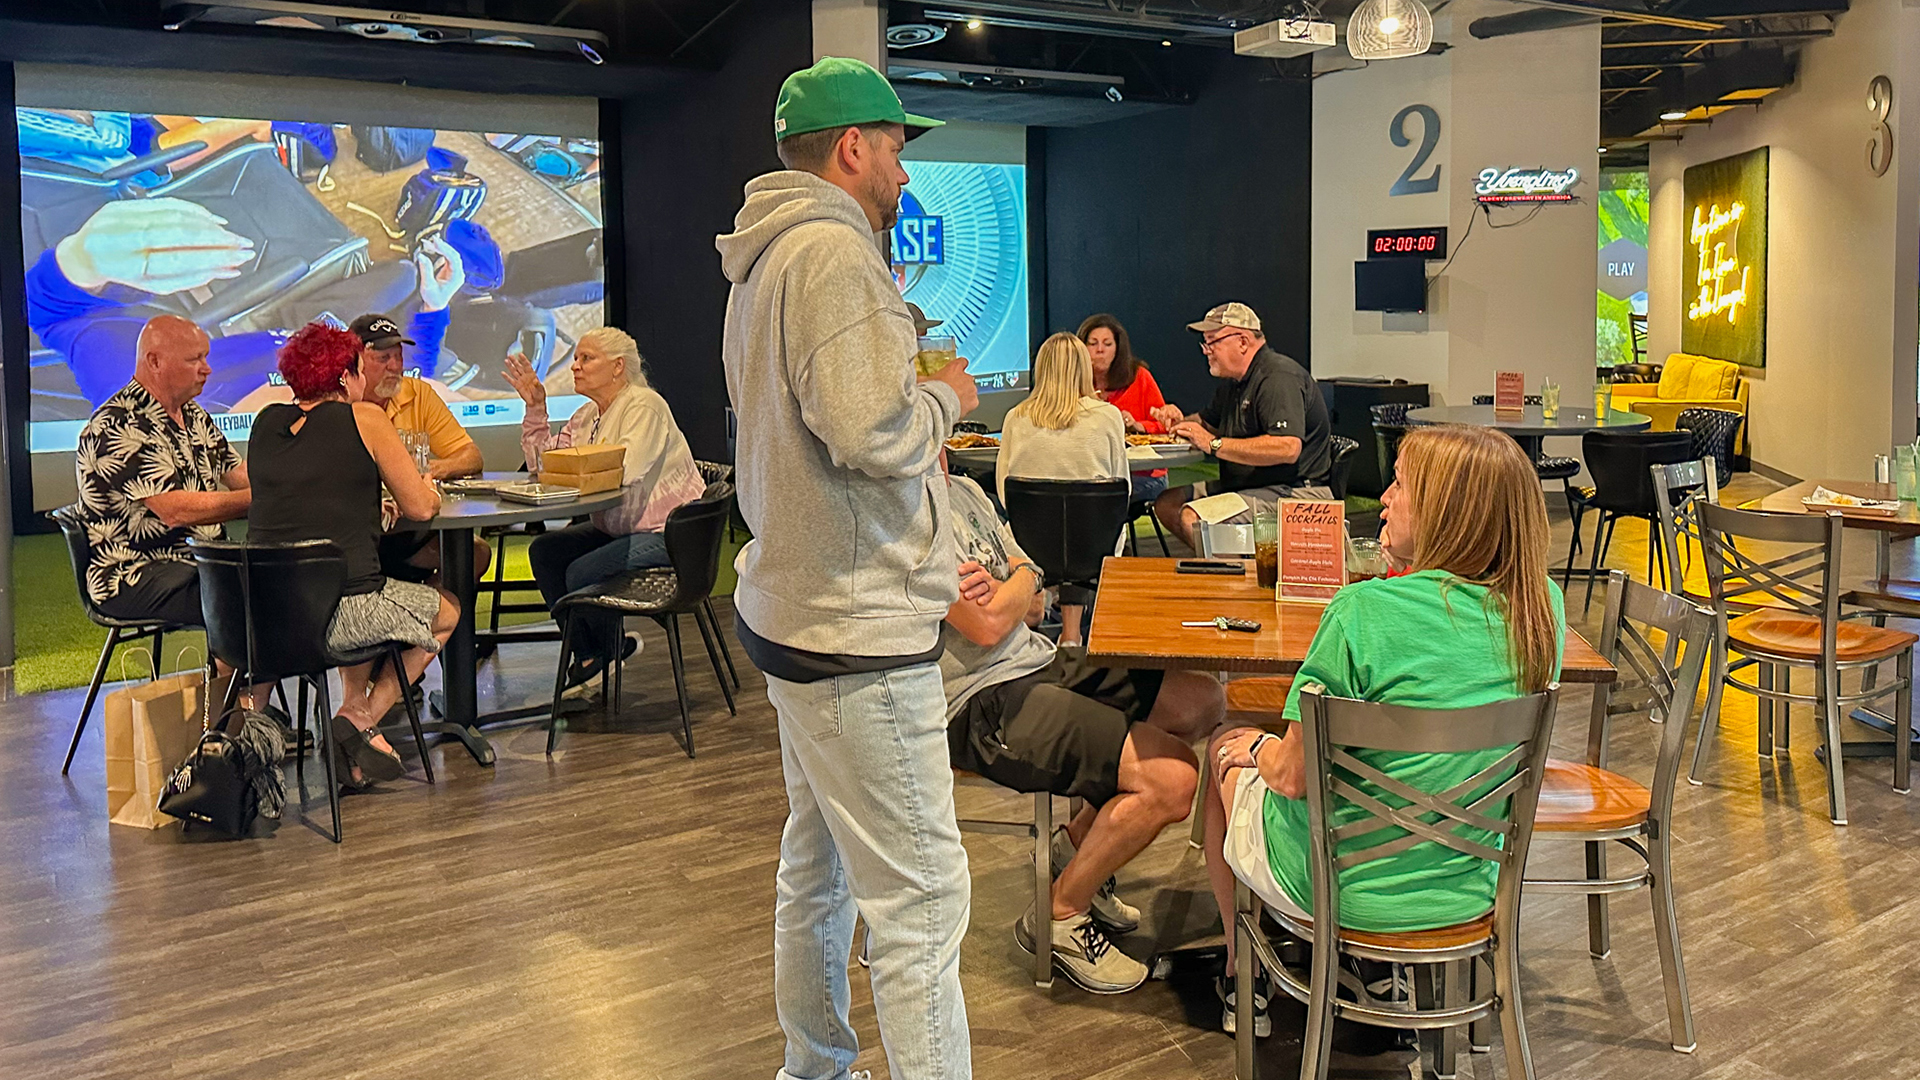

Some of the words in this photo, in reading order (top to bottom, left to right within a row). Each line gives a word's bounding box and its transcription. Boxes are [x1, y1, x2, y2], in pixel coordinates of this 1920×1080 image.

[1864, 75, 1893, 178] 3
[1389, 104, 1441, 196] 2
[1476, 167, 1577, 194] Yuengling
[1375, 235, 1436, 252] 02:00:00
[1608, 262, 1635, 277] PLAY
[1293, 503, 1331, 514] FALL
[1286, 514, 1338, 525] COCKTAILS
